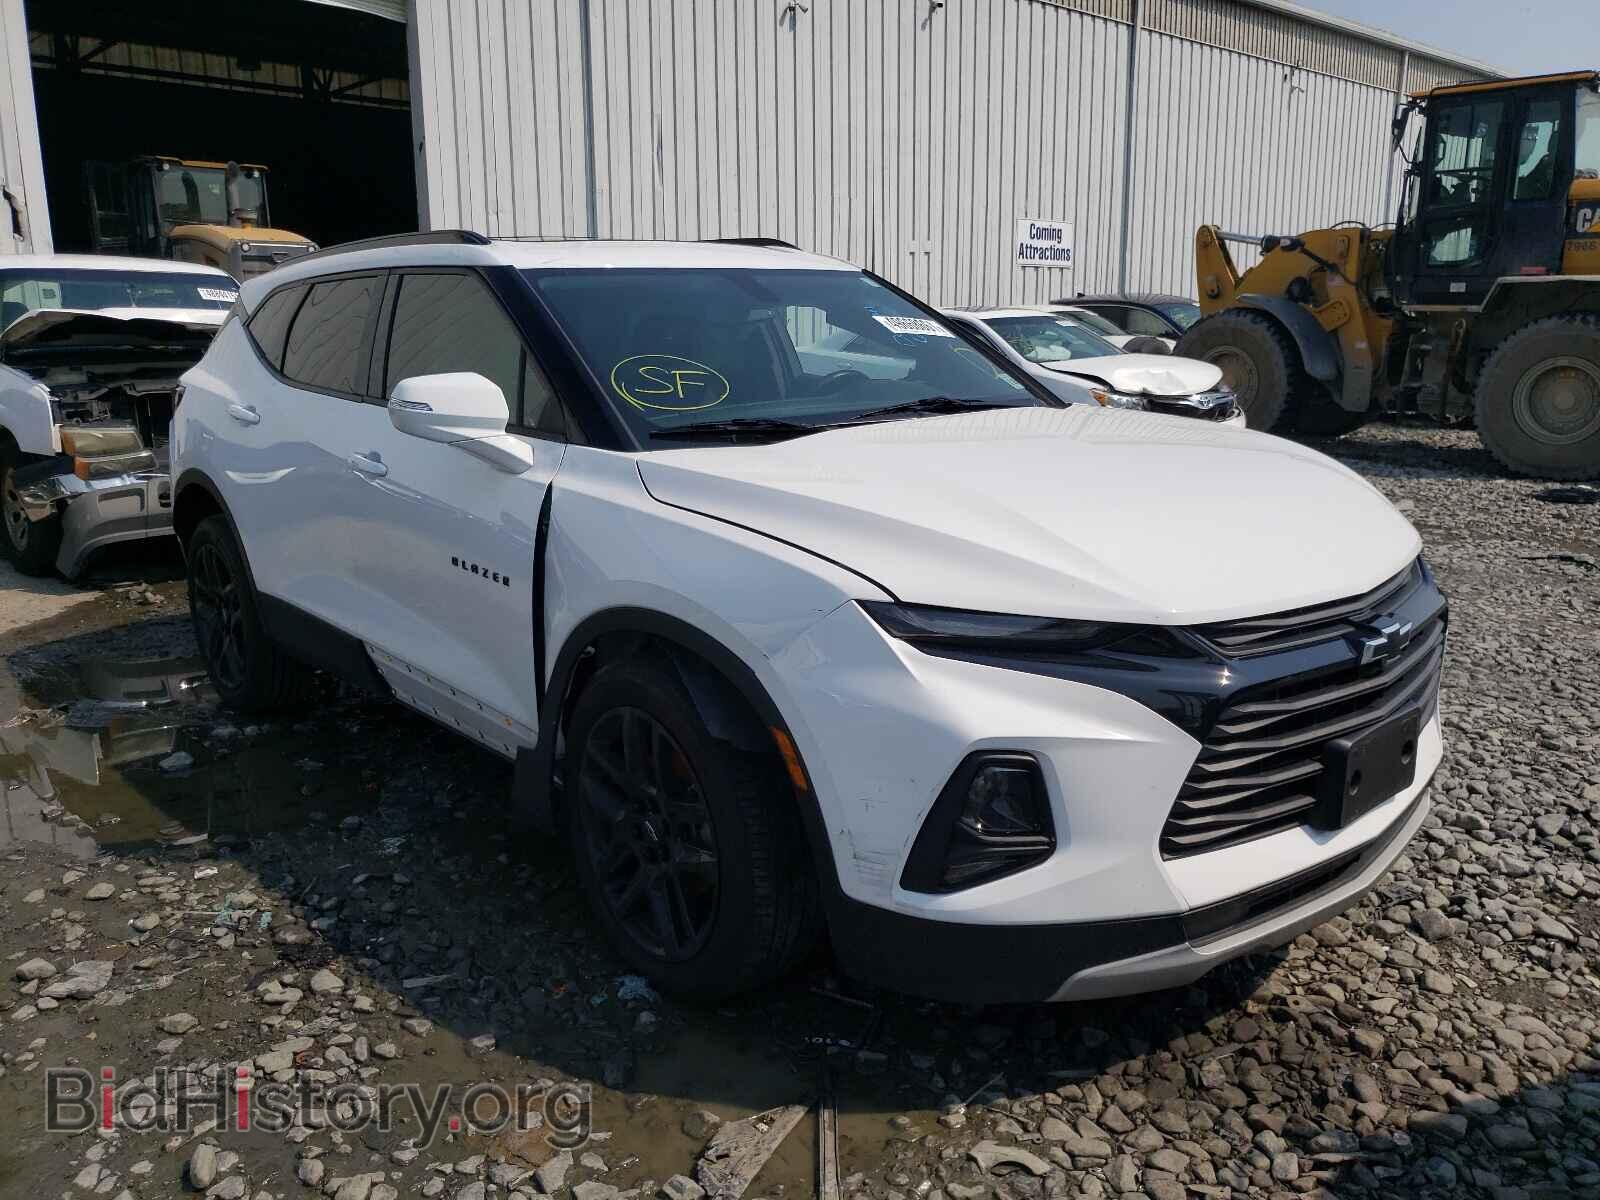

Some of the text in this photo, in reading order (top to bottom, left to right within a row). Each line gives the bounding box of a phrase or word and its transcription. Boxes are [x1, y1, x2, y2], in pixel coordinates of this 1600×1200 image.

[1030, 223, 1062, 244] Coming
[1018, 242, 1071, 262] Attractions
[635, 366, 711, 399] SF
[451, 556, 510, 587] BLAZER
